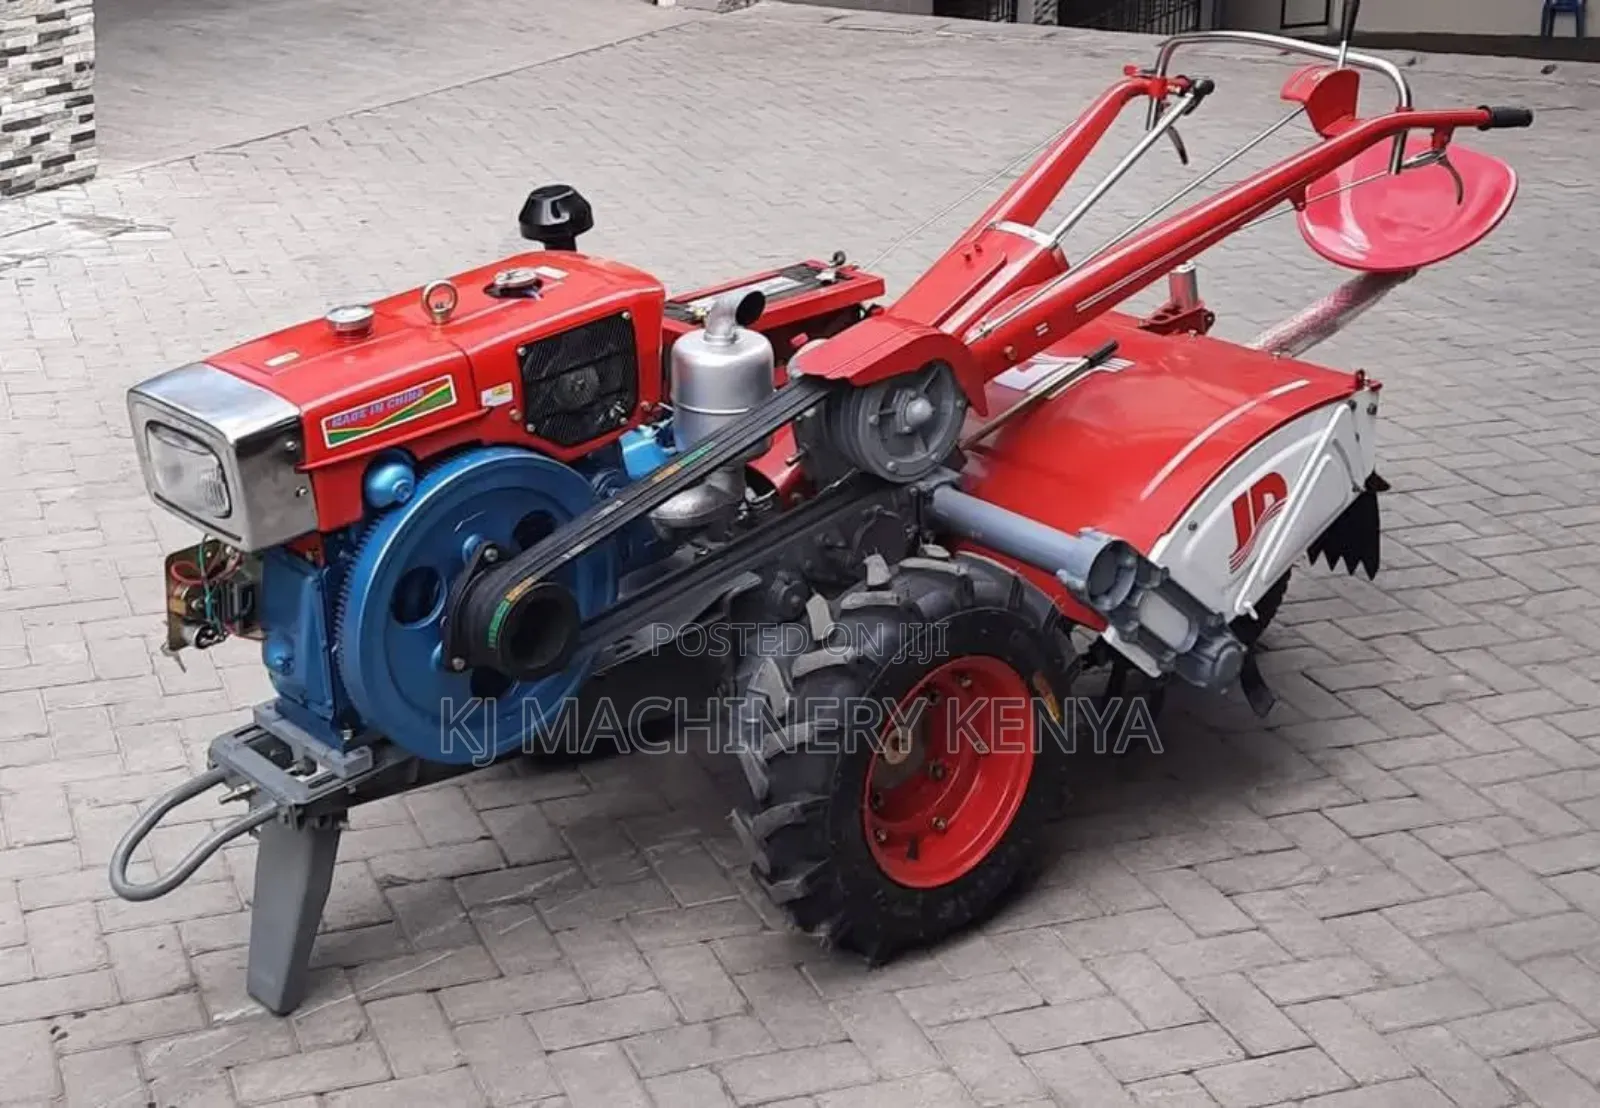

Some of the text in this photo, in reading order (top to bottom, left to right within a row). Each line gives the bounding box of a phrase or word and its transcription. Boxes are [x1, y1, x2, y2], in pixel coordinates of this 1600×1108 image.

[331, 387, 425, 427] MADE IN CHINA
